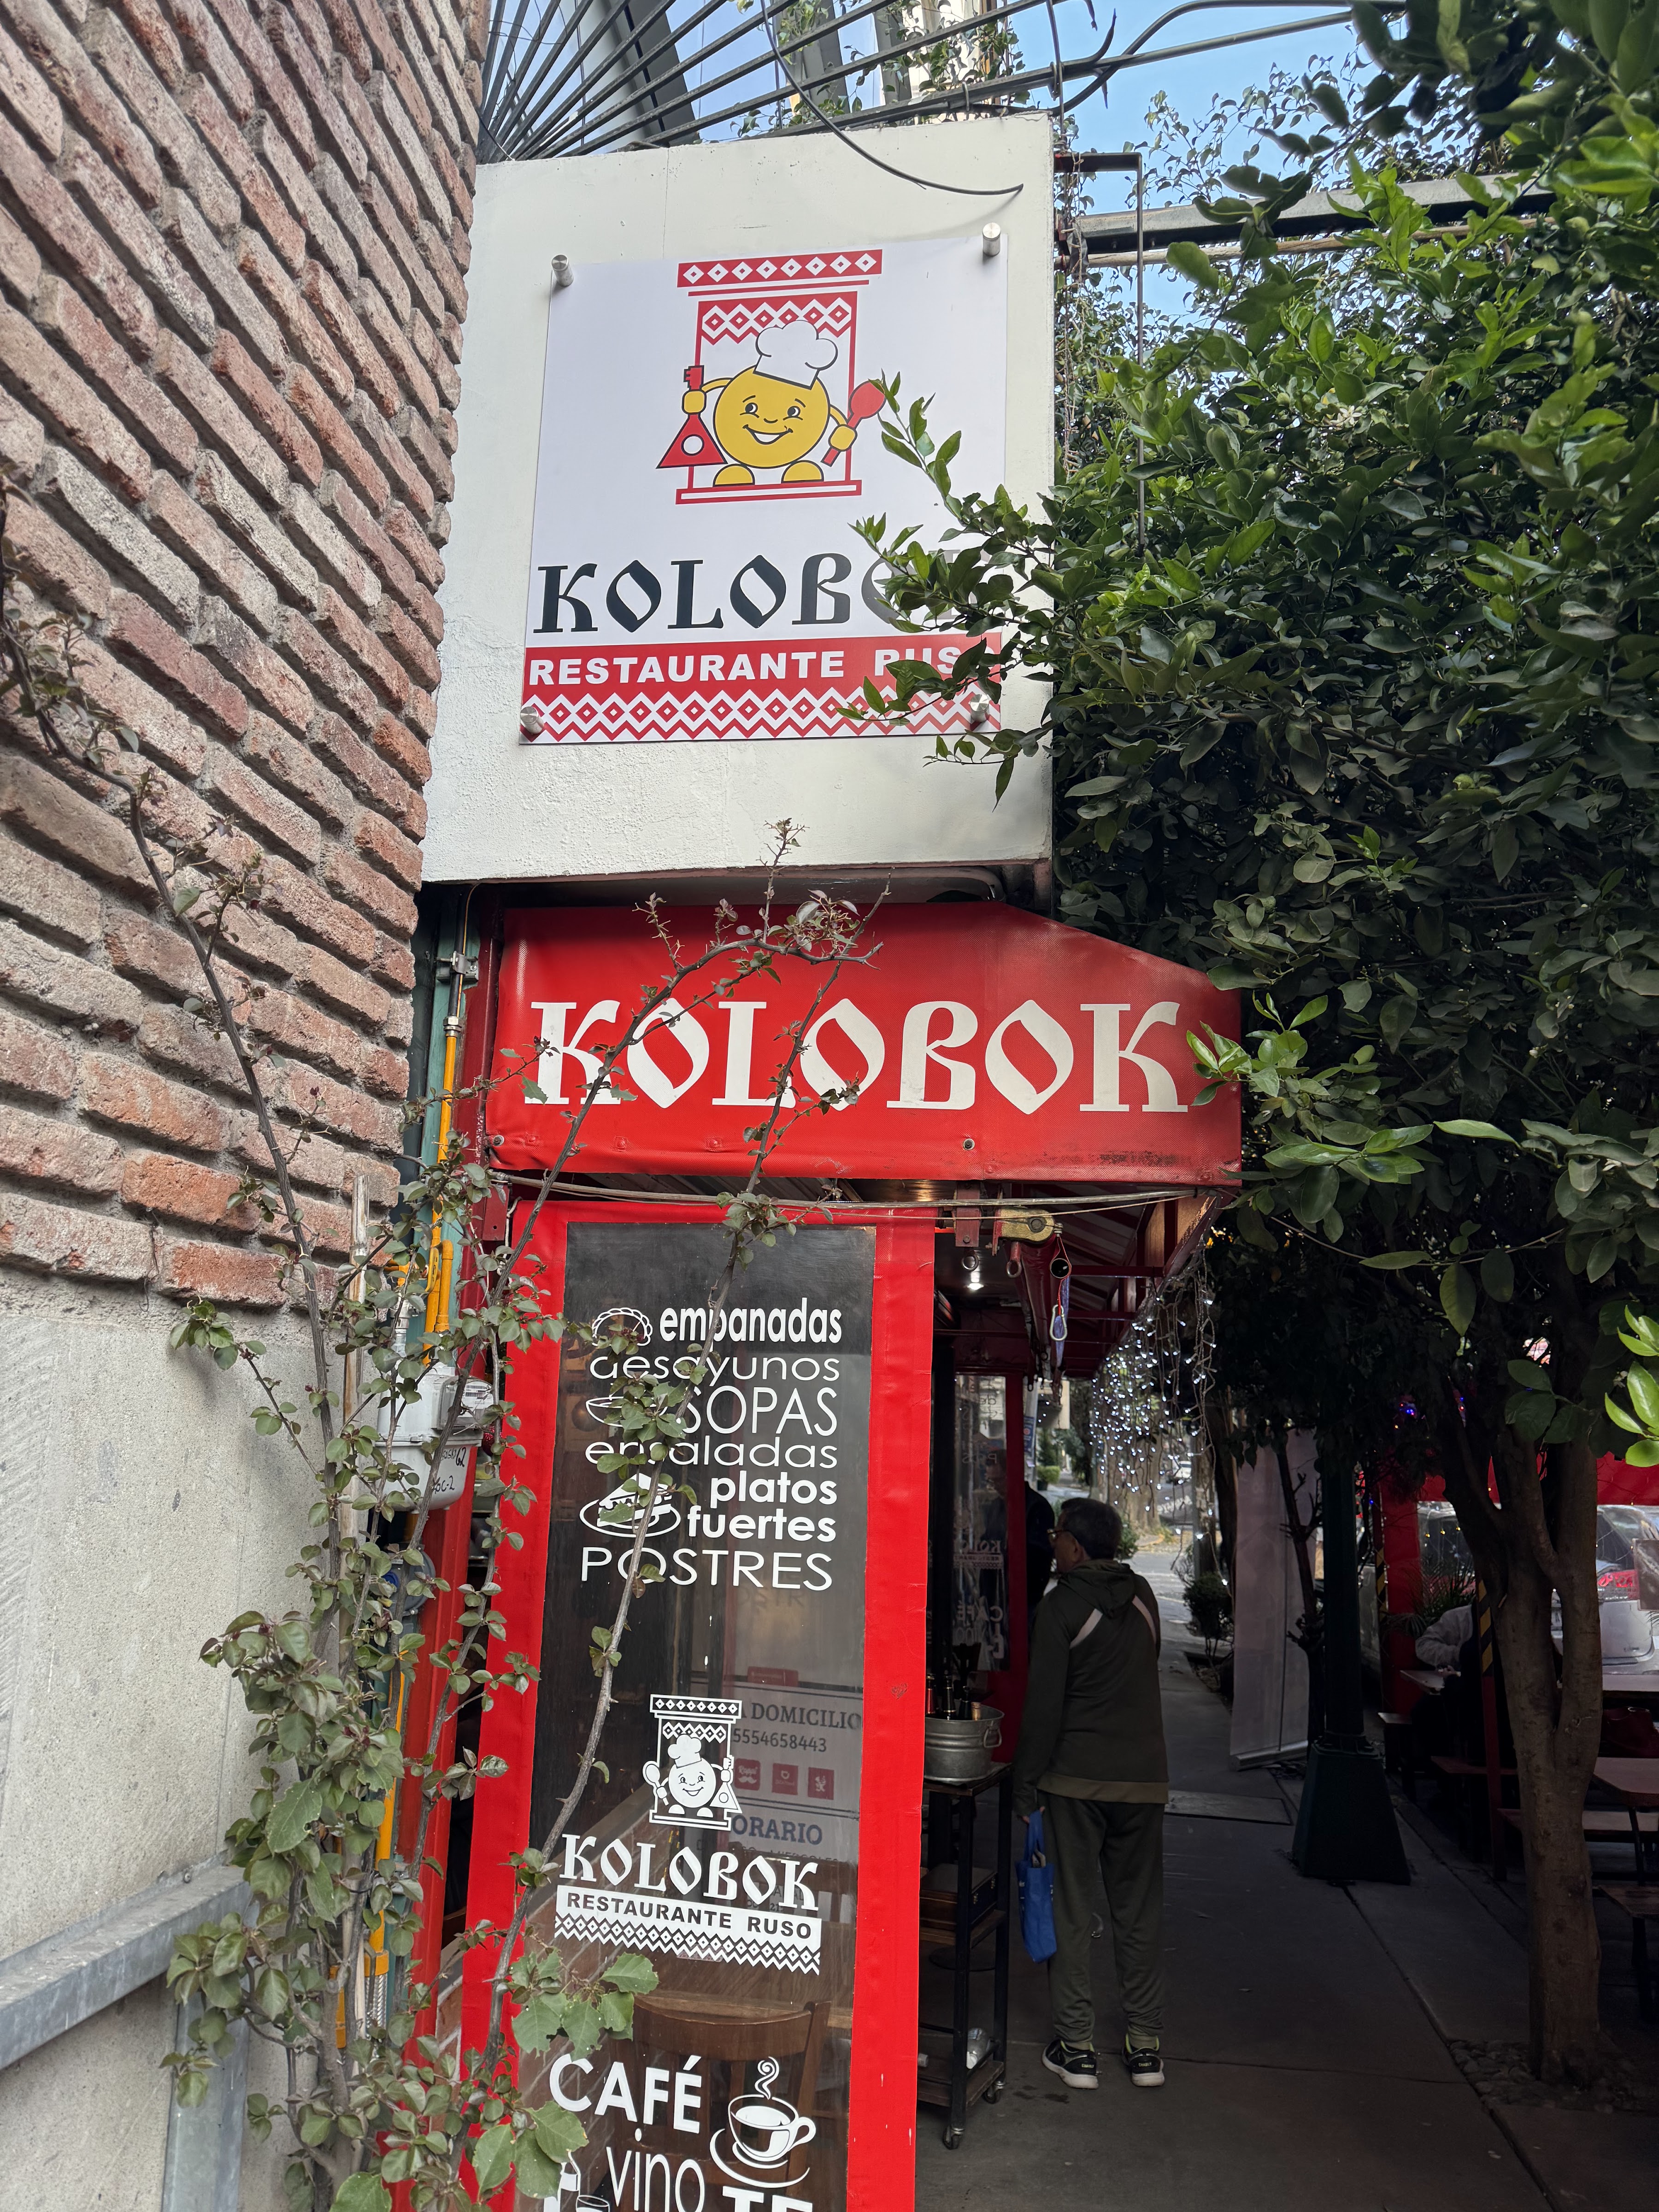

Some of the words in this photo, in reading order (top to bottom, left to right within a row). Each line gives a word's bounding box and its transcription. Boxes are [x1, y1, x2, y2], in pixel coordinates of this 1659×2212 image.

[533, 548, 998, 633] KOLOBO
[529, 651, 844, 685] RESTAURANTE
[875, 647, 994, 676] RS
[524, 997, 1188, 1114] KOLOBOK
[659, 1297, 842, 1353] empanadas
[710, 1470, 837, 1509] platos
[687, 1505, 836, 1542] fuertes
[582, 1547, 832, 1591] POSTRES
[751, 1703, 862, 1730] DOMICILIO
[733, 1729, 827, 1752] 5554658443
[732, 1815, 823, 1845] ORARIO
[559, 1834, 819, 1911] KOLOBOK
[567, 1892, 732, 1929] RESTAURANTE
[747, 1916, 812, 1939] RUSO
[549, 2054, 702, 2134] CAFÉ
[606, 2128, 705, 2212] vino
